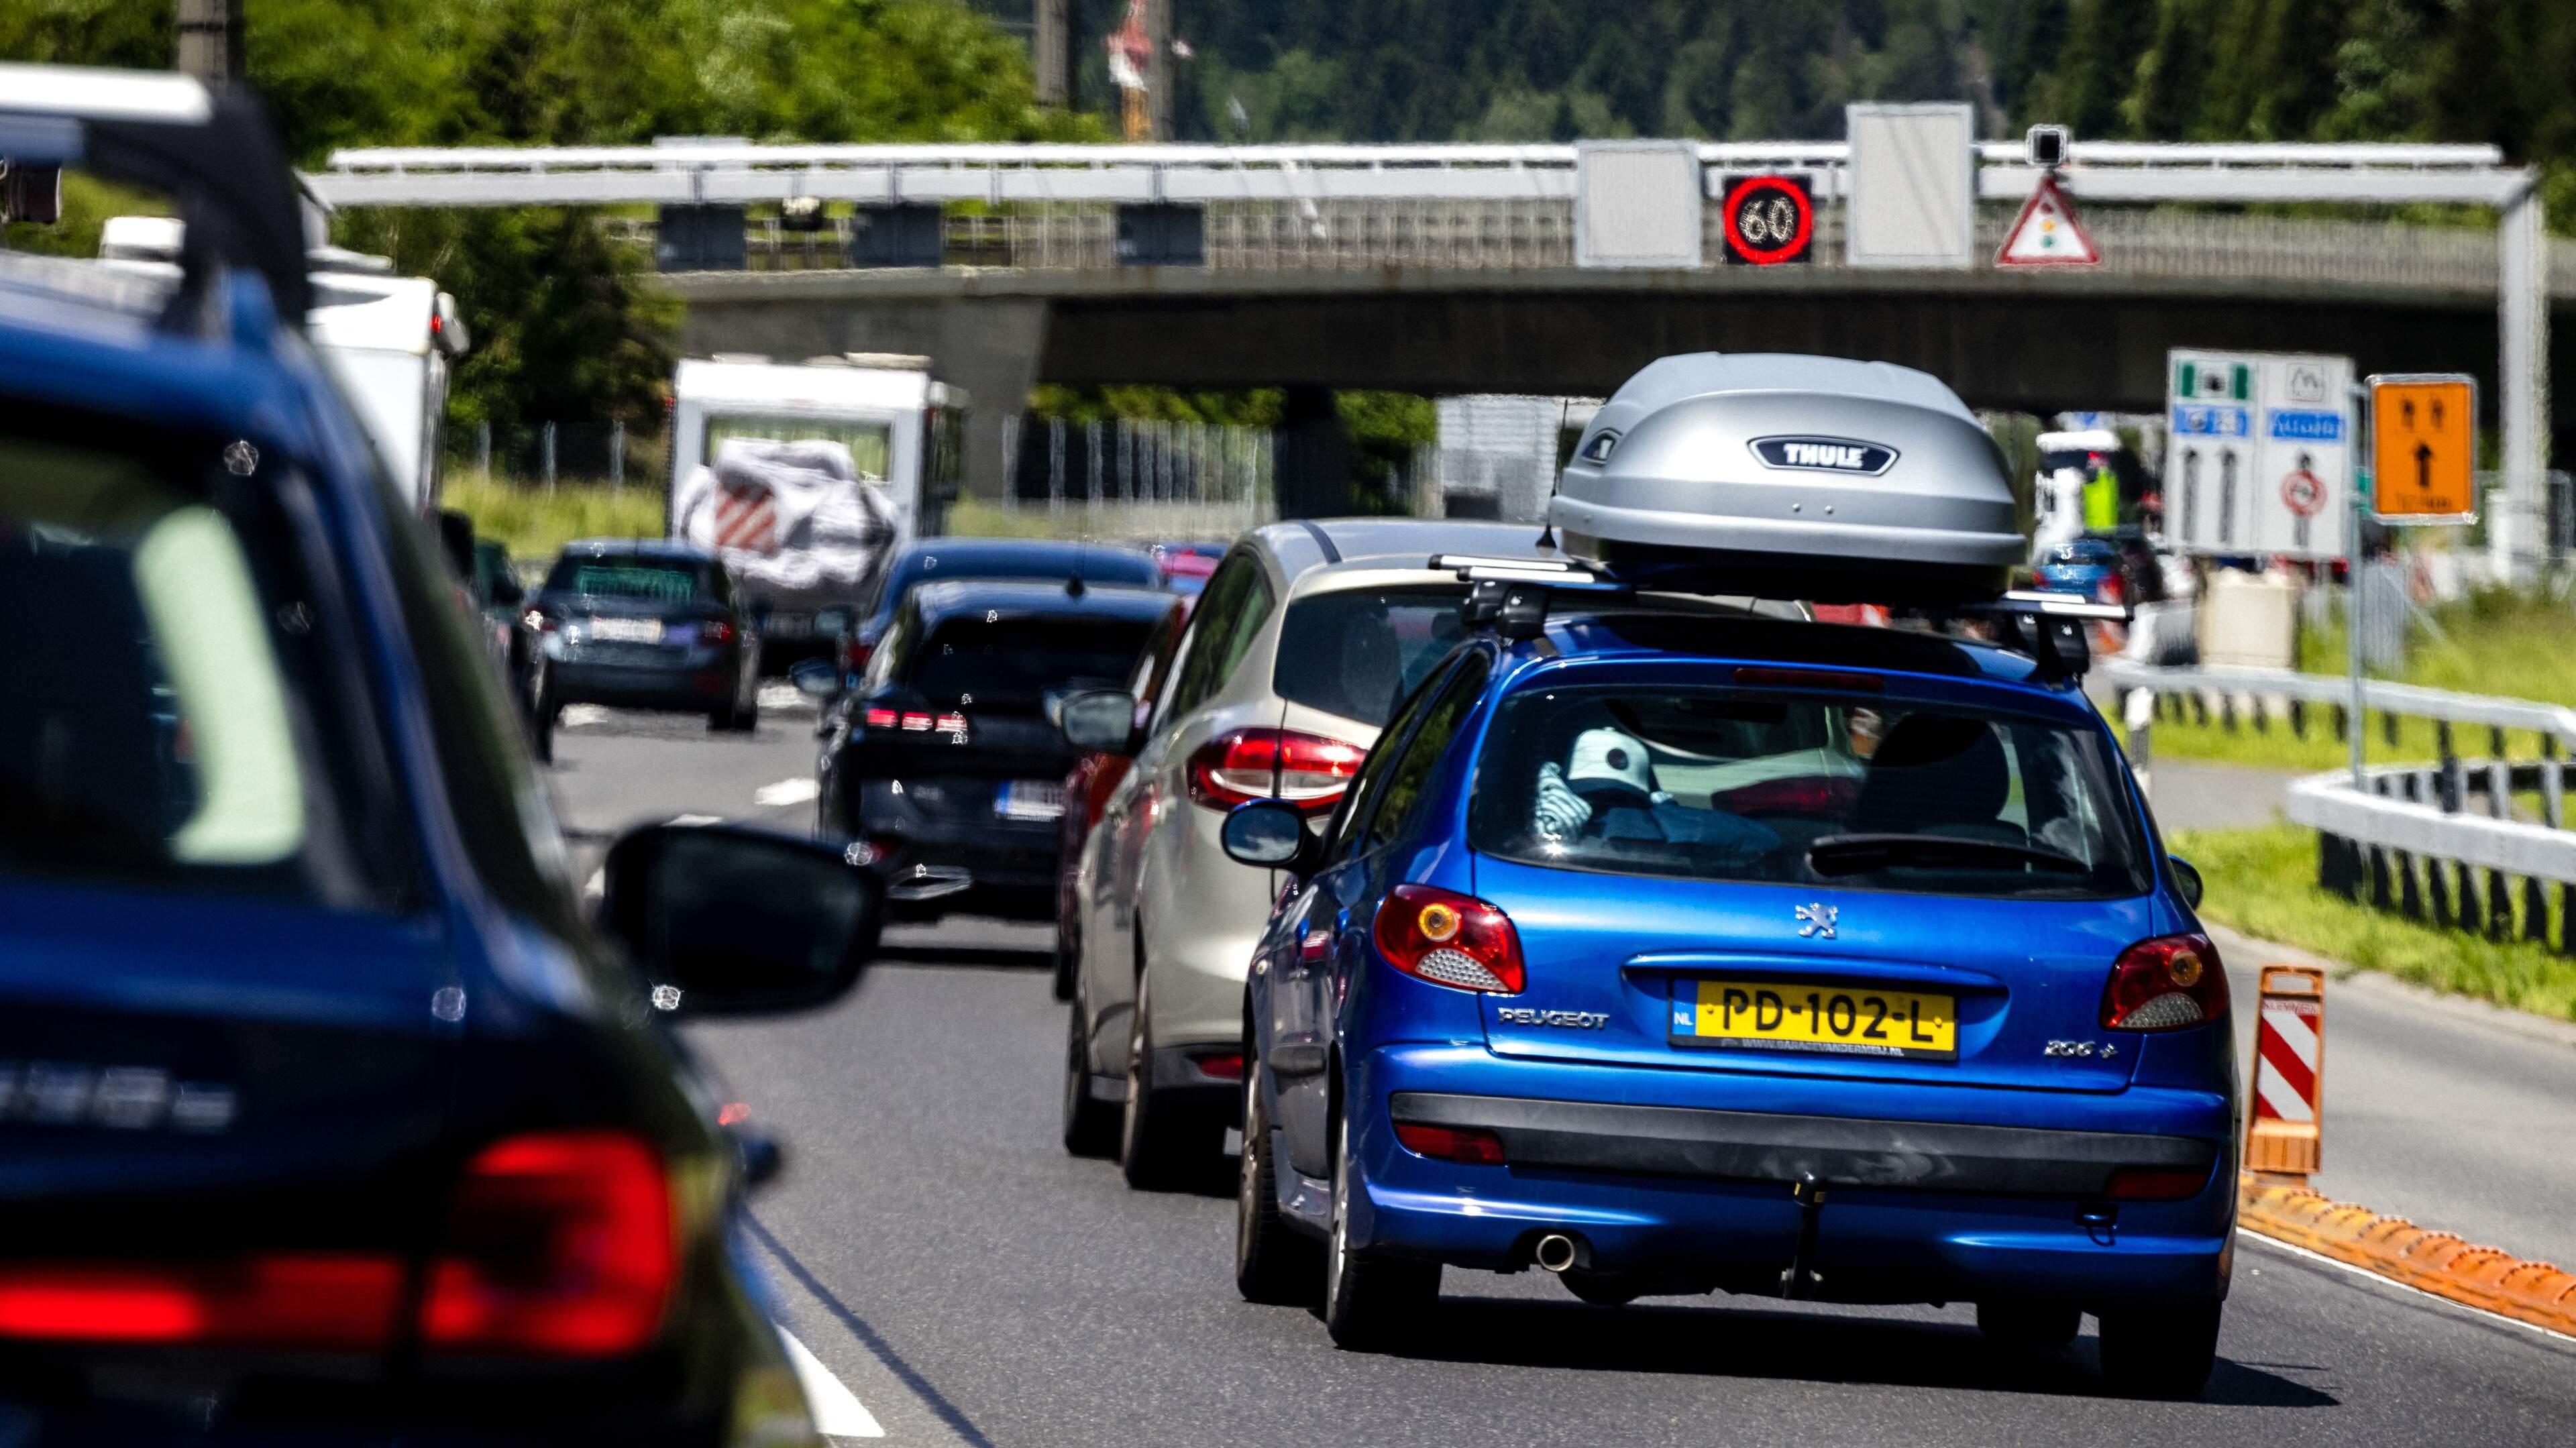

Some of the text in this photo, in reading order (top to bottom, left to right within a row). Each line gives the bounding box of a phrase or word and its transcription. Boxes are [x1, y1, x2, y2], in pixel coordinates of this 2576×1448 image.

[1739, 197, 1794, 243] 60
[1782, 443, 1864, 469] THULE
[1497, 1007, 1611, 1029] PEUGEOT
[1674, 1011, 1693, 1025] NL
[1722, 988, 1935, 1042] PD-102-L
[2044, 1040, 2096, 1058] 206
